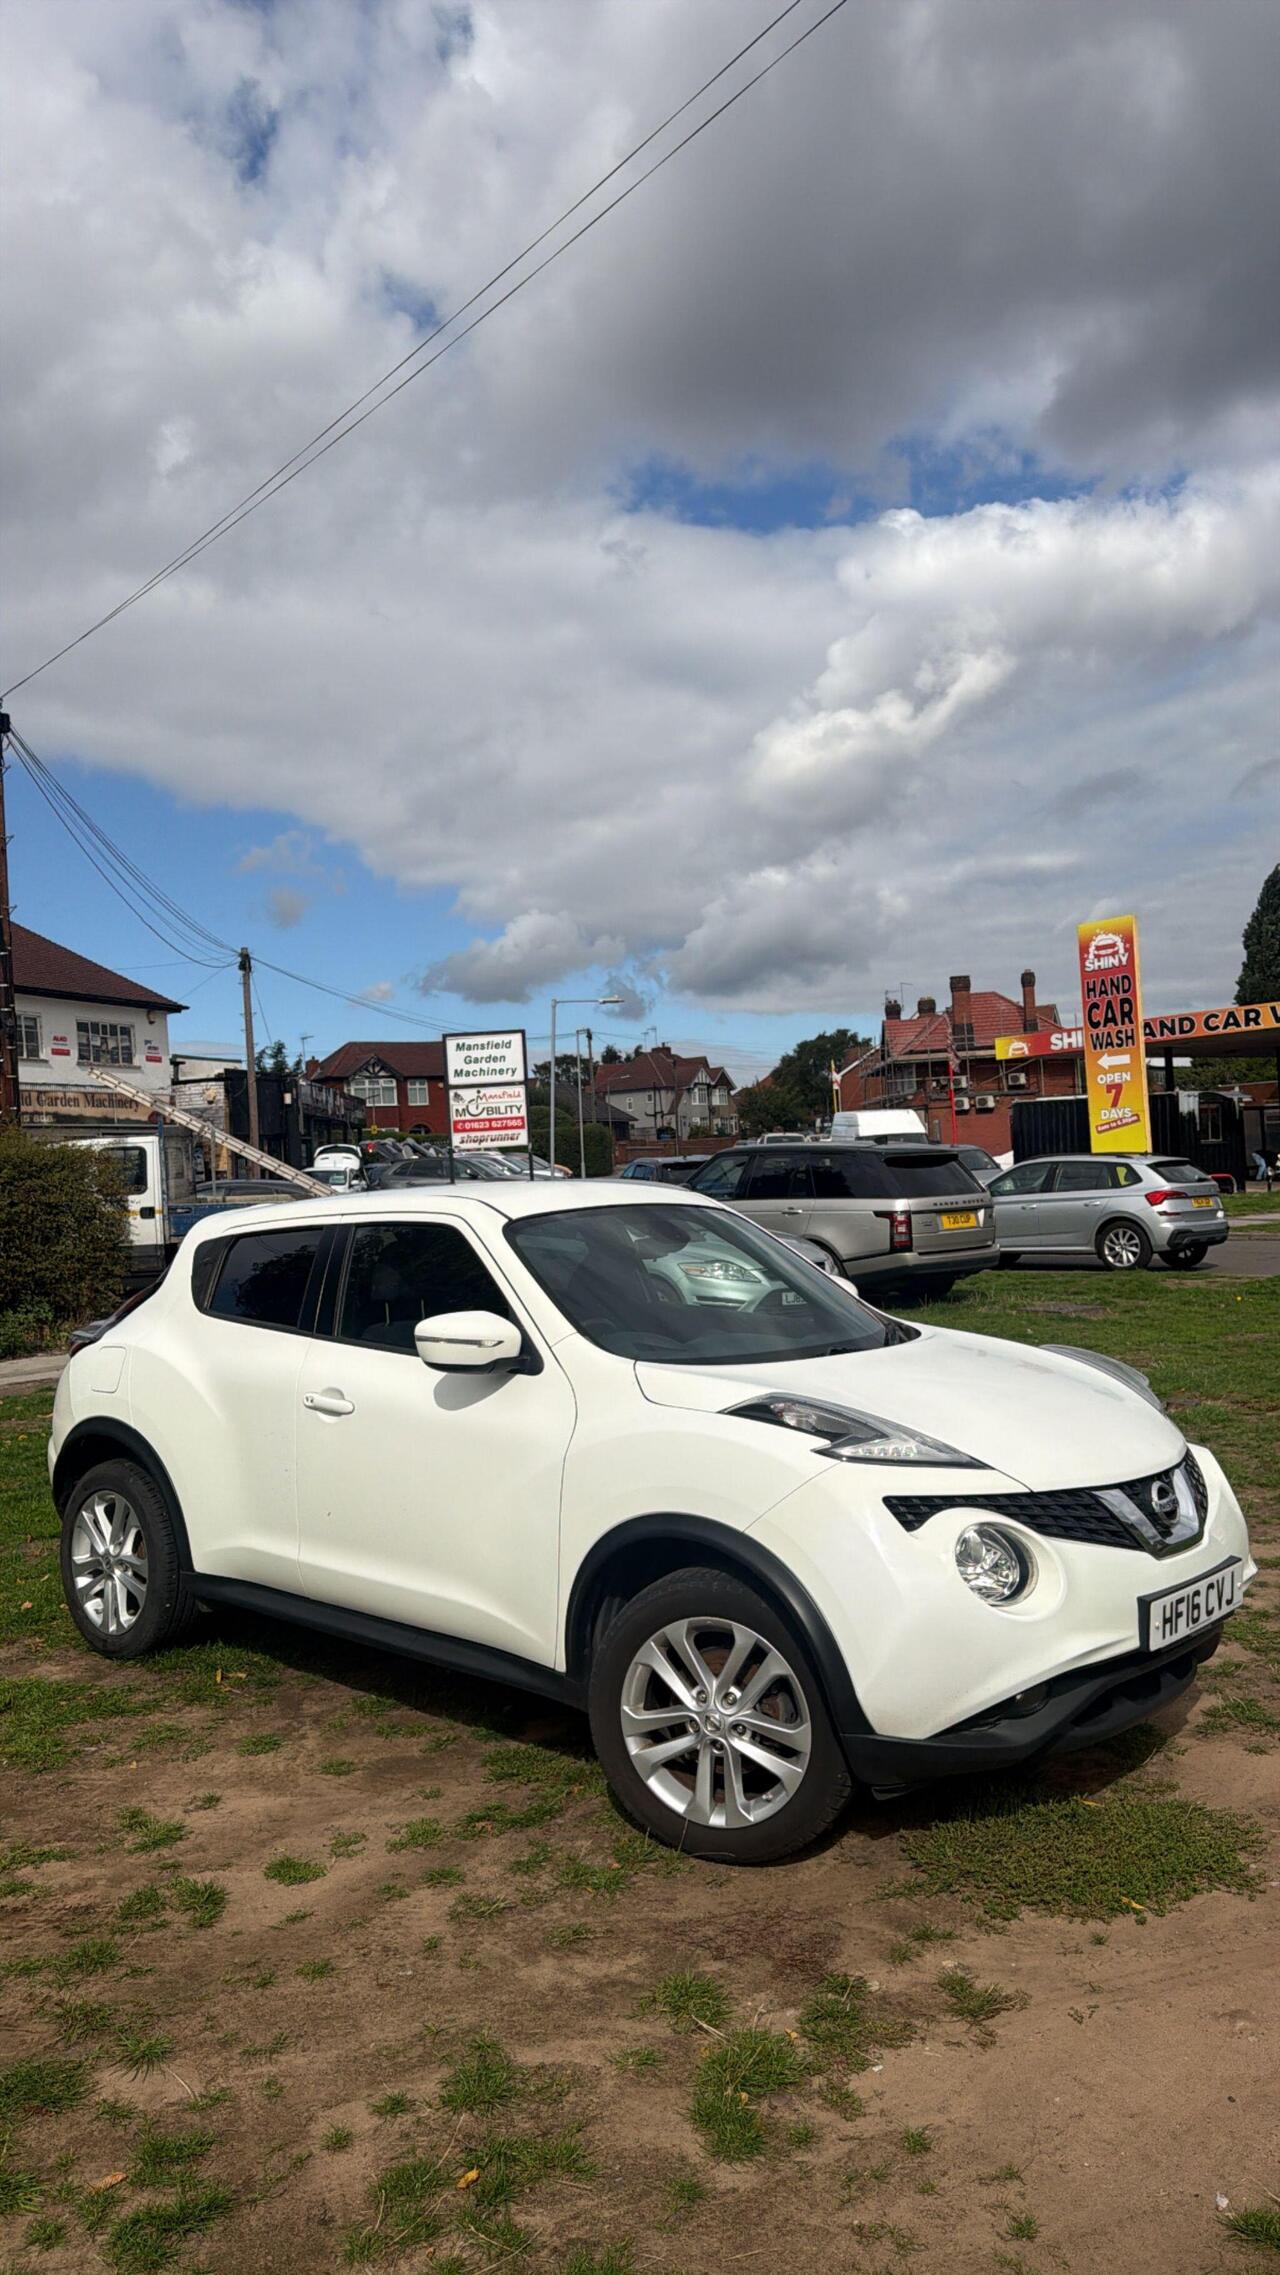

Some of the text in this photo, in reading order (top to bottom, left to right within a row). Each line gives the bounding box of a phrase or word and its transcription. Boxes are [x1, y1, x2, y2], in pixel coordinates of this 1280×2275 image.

[1084, 952, 1129, 972] SHINY
[1086, 974, 1132, 999] HAND
[1087, 997, 1134, 1030] CAR
[1050, 1030, 1083, 1051] SHI
[1143, 1016, 1196, 1039] AND
[1203, 1008, 1261, 1032] CAR
[1090, 1028, 1135, 1051] WASH
[455, 1039, 512, 1052] Mansfield
[463, 1054, 506, 1065] Garden
[453, 1067, 517, 1078] Machinery
[1097, 1071, 1131, 1084] OPEN
[37, 1091, 80, 1108] Garden
[84, 1092, 140, 1113] Machinery
[1105, 1083, 1123, 1108] 7
[1101, 1107, 1132, 1120] DAYS
[459, 1132, 521, 1145] shoprunner
[1162, 1570, 1234, 1640] HF16 CVJ
